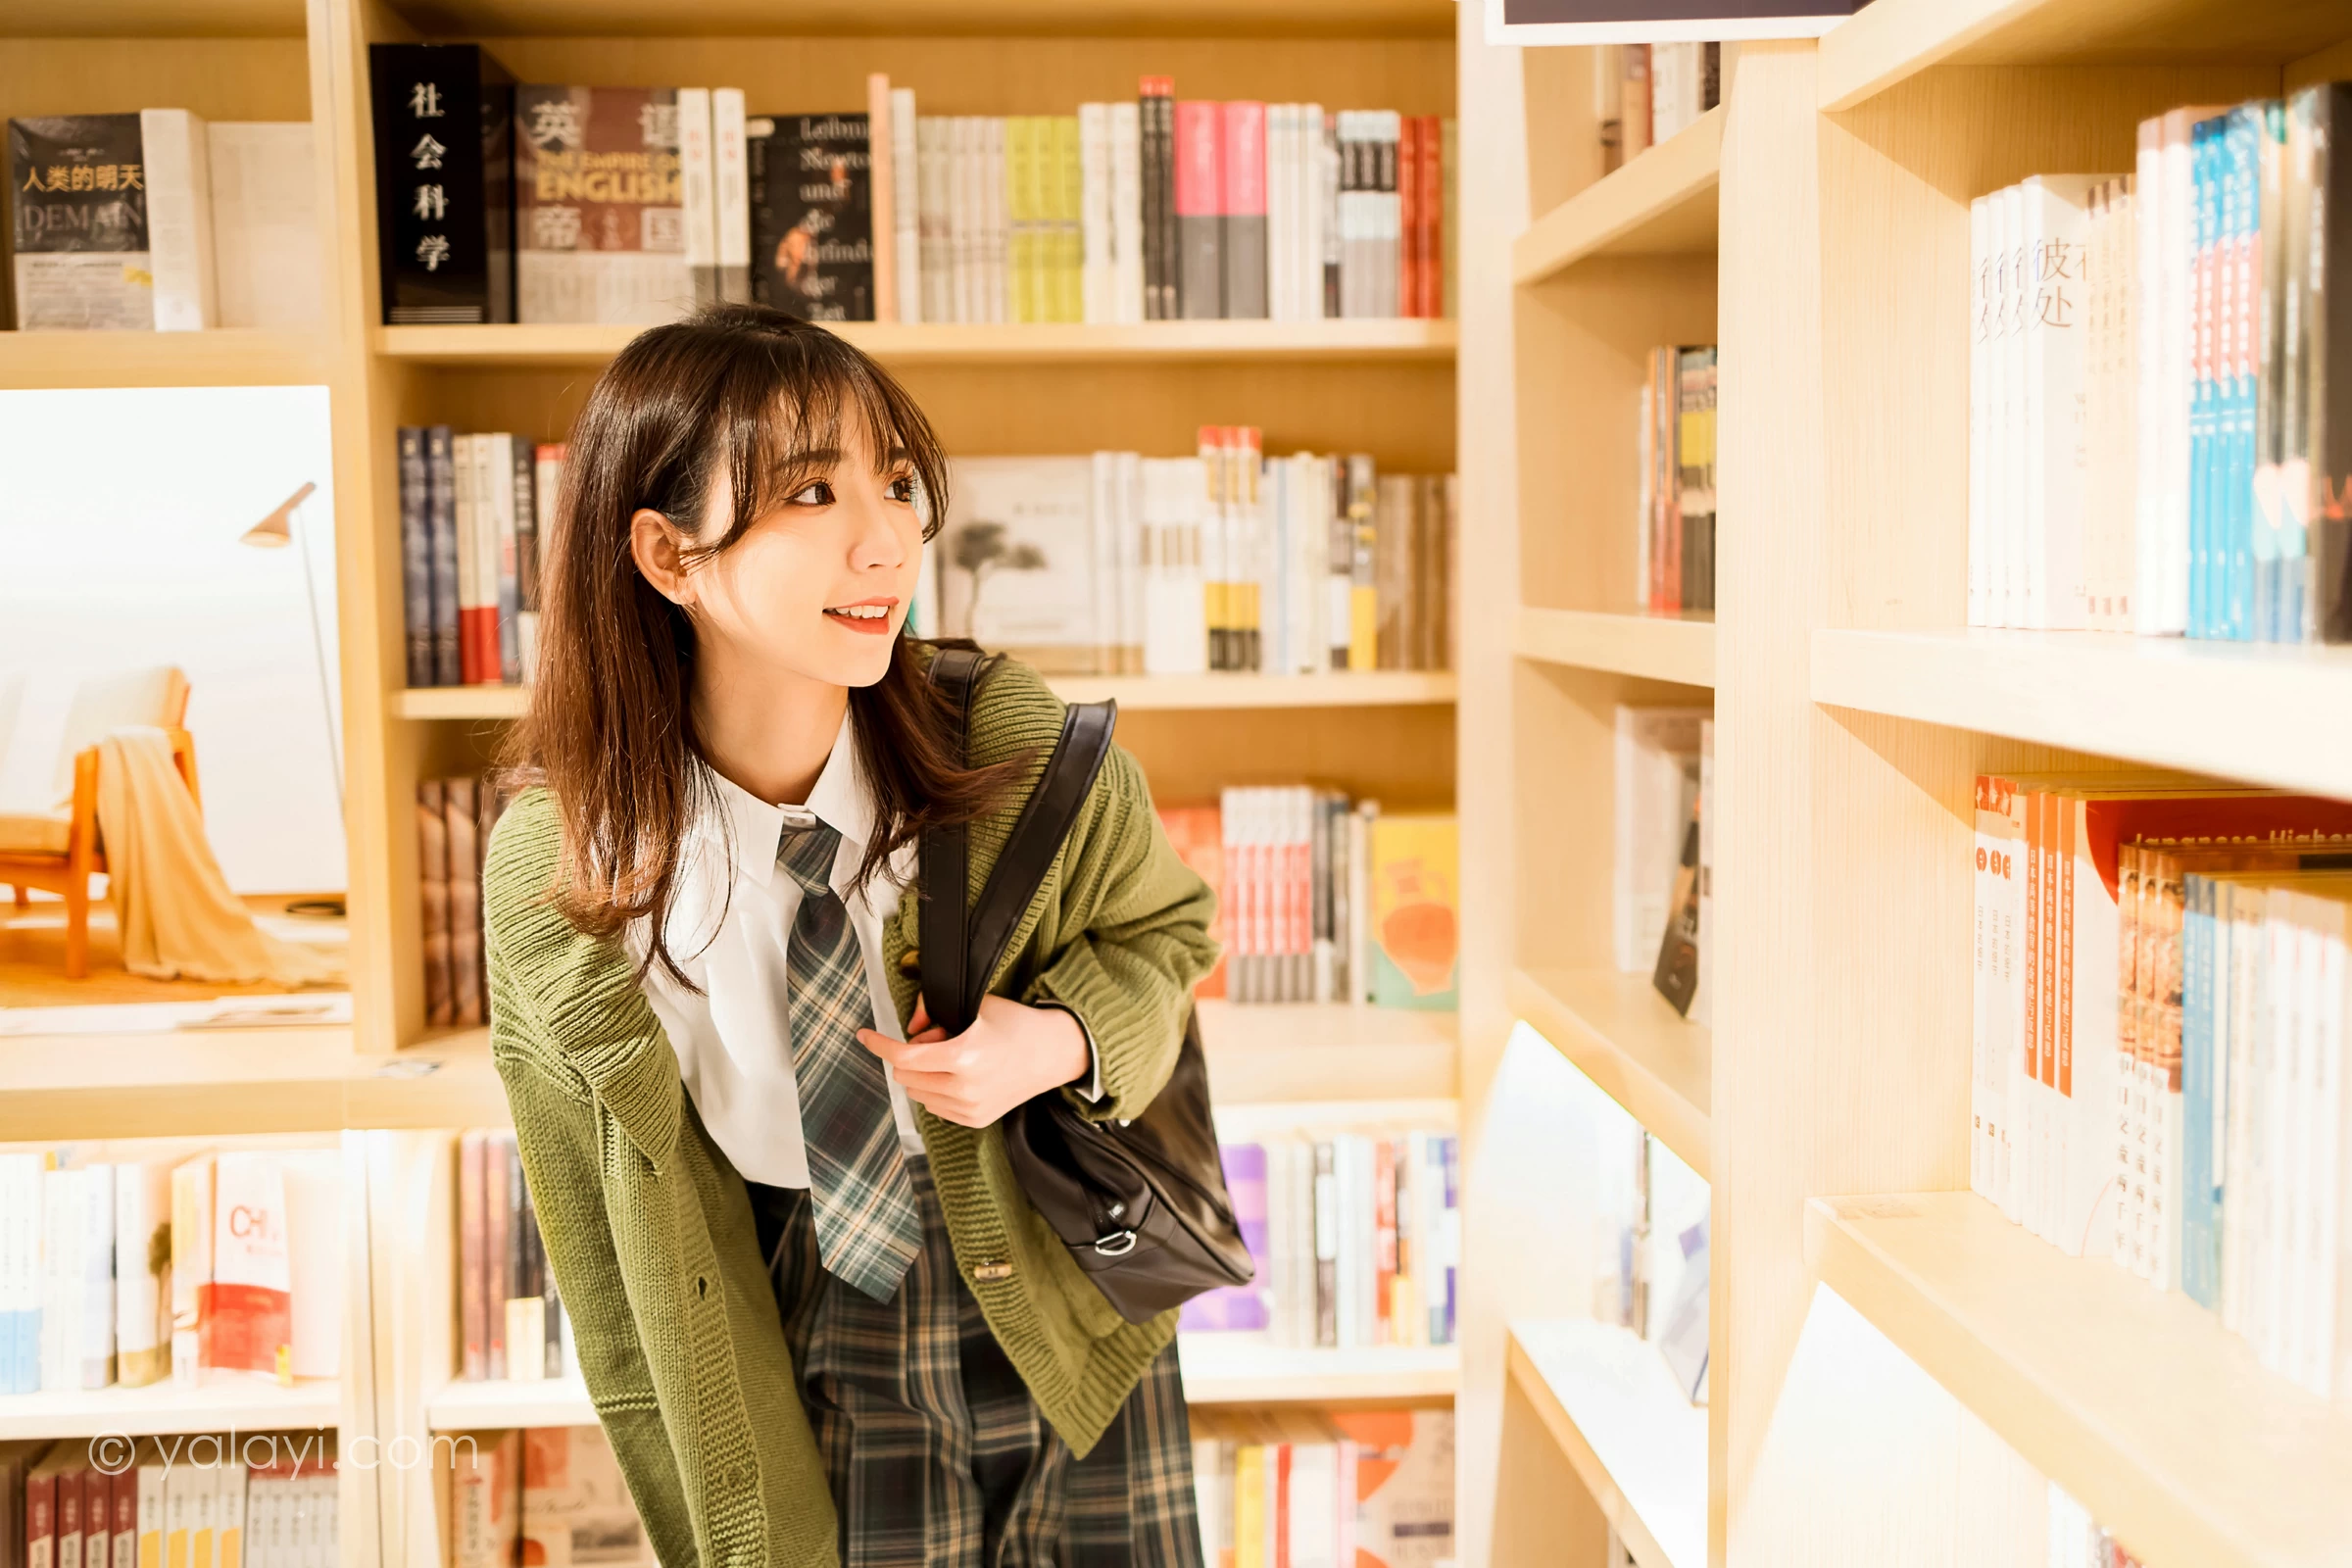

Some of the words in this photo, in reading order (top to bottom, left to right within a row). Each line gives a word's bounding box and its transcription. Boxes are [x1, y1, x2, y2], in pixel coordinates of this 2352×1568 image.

[799, 147, 871, 172] Newto
[22, 163, 145, 193] 人类的明天
[408, 81, 451, 272] 社会科学
[535, 170, 683, 204] ENGLISH
